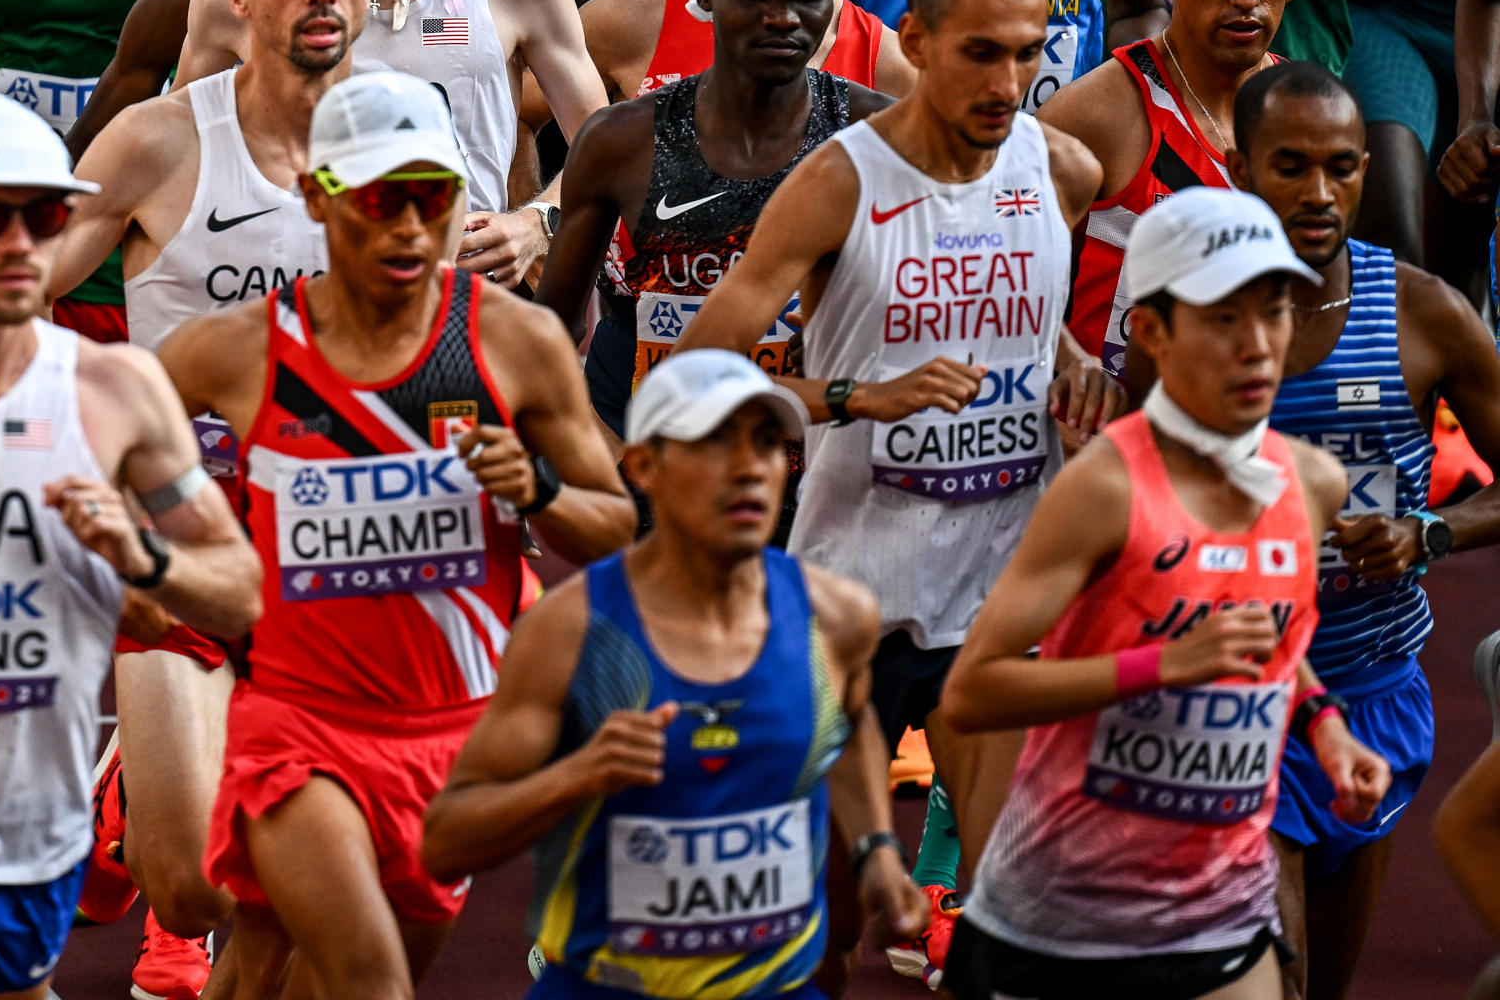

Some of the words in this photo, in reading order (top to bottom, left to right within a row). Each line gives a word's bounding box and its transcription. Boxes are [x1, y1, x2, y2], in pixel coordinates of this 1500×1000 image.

[38, 82, 100, 118] TD
[1202, 225, 1274, 258] JAPAN
[206, 264, 325, 303] CAN
[662, 252, 746, 288] UGA
[896, 251, 1035, 299] GREAT
[884, 297, 1045, 345] BRITAIN
[962, 364, 1036, 409] DK
[887, 413, 1039, 463] CAIRESS
[328, 457, 461, 503] TDK
[290, 508, 473, 563] CHAMPI
[1143, 601, 1294, 640] JAN
[1168, 689, 1279, 730] TDK
[1104, 726, 1269, 781] KOYAMA
[670, 812, 793, 867] TDK
[647, 866, 781, 918] JAMI
